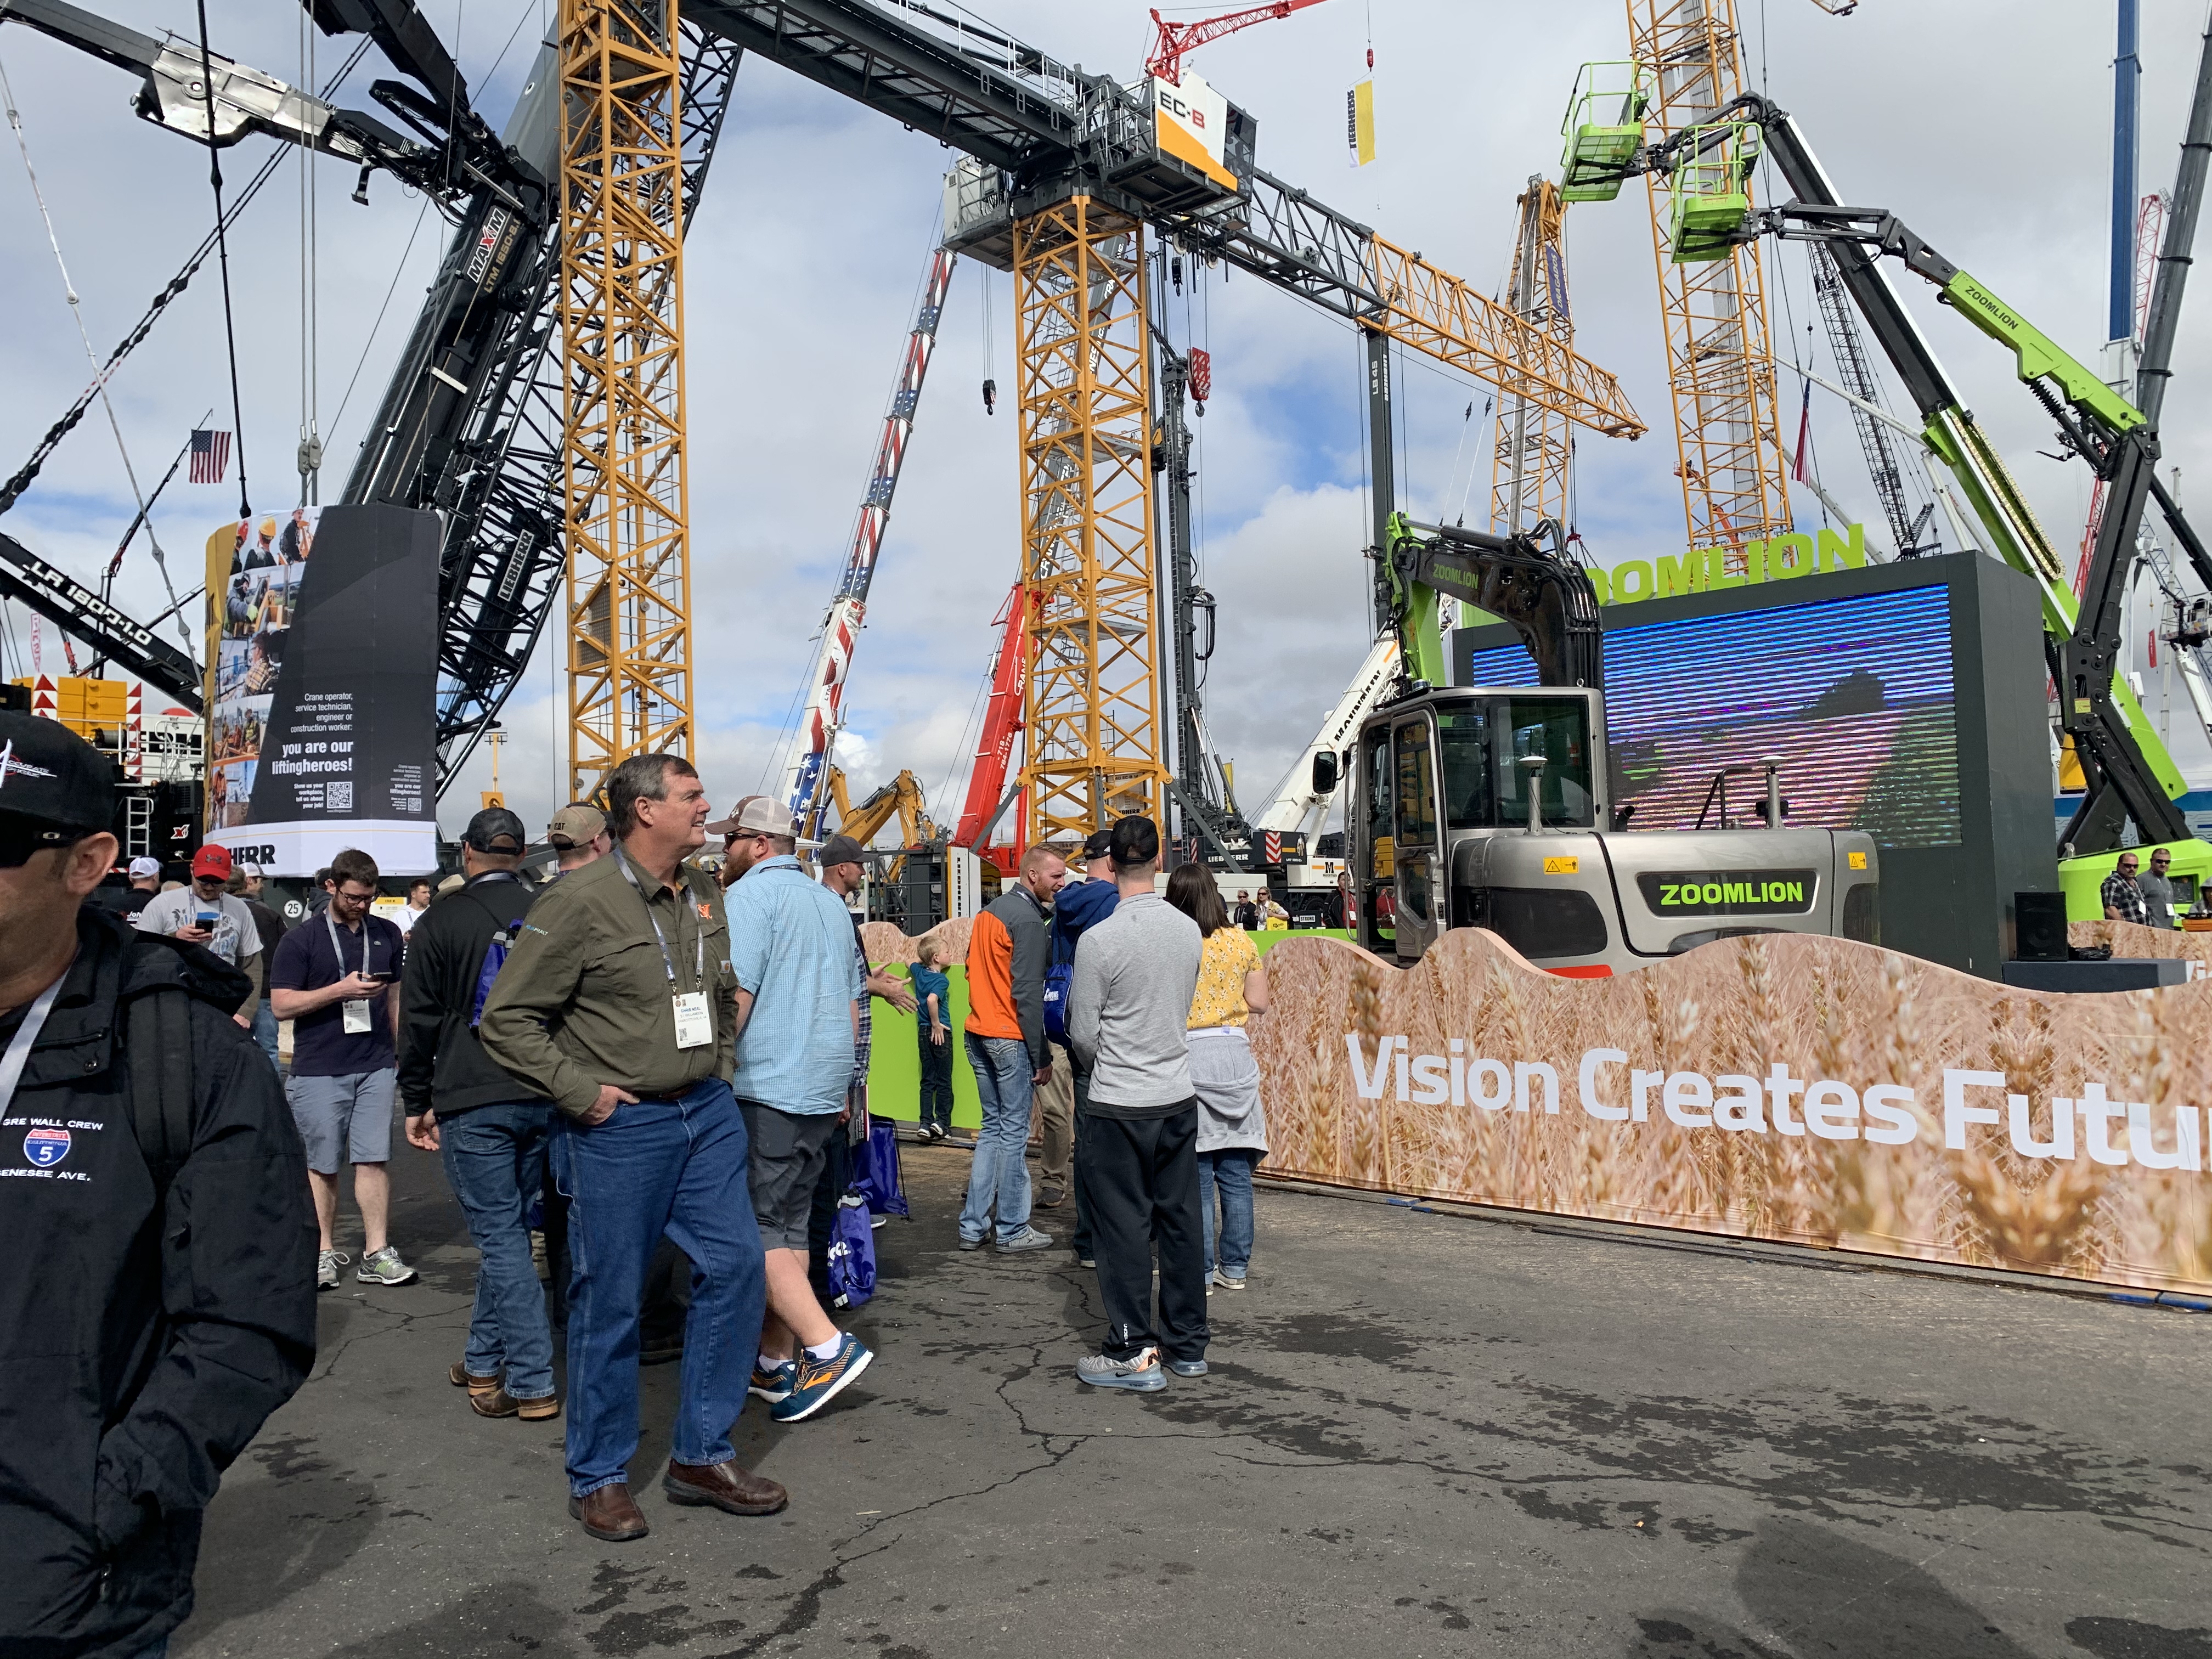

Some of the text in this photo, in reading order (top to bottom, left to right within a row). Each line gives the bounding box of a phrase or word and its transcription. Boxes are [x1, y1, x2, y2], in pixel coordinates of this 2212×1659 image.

[1159, 89, 1205, 129] EC-B
[467, 208, 506, 284] MAXIM
[483, 266, 500, 294] LTM
[1551, 253, 1563, 309] DRAGADOS
[1965, 285, 2019, 330] ZOOMLION
[1372, 360, 1379, 395] LB 45
[30, 561, 64, 588] LR
[499, 532, 533, 600] LIEBHERR
[1432, 563, 1479, 589] ZOOMLION
[304, 692, 353, 702] Crane operator,
[295, 703, 353, 712] service technician,
[316, 714, 344, 722] engineer
[290, 723, 353, 733] construction worker:
[282, 741, 354, 758] you are our
[272, 758, 352, 776] liftingheroes!
[1208, 854, 1249, 863] LIEBERR
[1325, 862, 1334, 873] M
[1660, 882, 1803, 905] ZOOMLION
[287, 903, 298, 914] 25
[1345, 1032, 2212, 1172] Vision Creates Futu
[30, 1118, 64, 1127] WALL
[67, 1120, 103, 1130] CREW
[38, 1146, 54, 1162] 5
[0, 1169, 91, 1181] ENESEE AVE.
